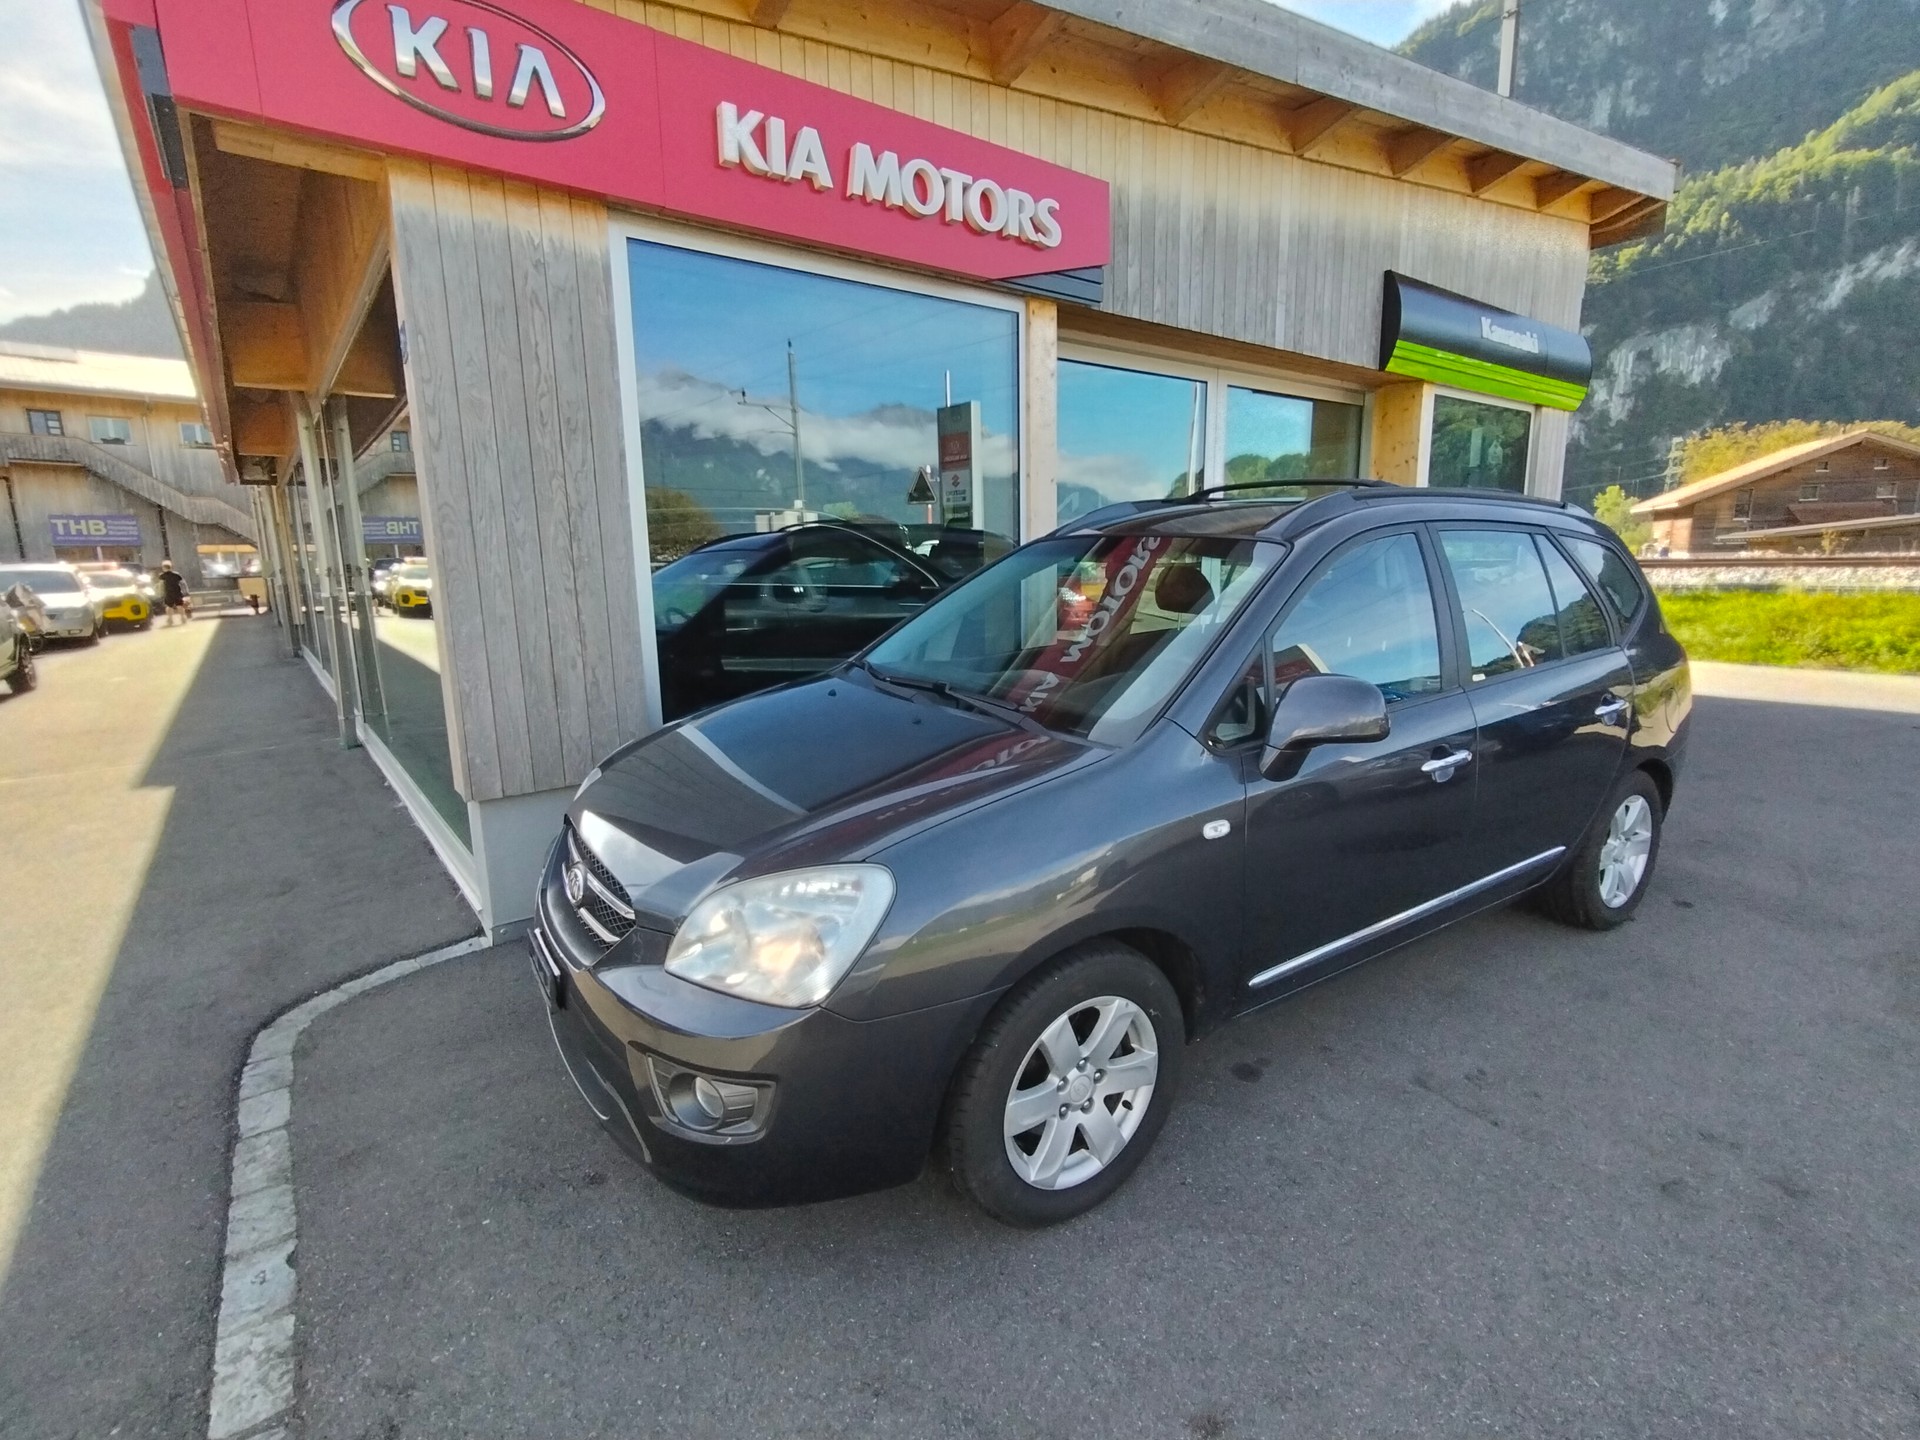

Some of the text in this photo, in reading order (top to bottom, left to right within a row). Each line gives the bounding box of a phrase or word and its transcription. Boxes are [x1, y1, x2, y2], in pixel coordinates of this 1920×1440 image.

[392, 5, 566, 119] KIA
[715, 101, 1062, 249] KIA MOTORS
[50, 519, 107, 535] THB
